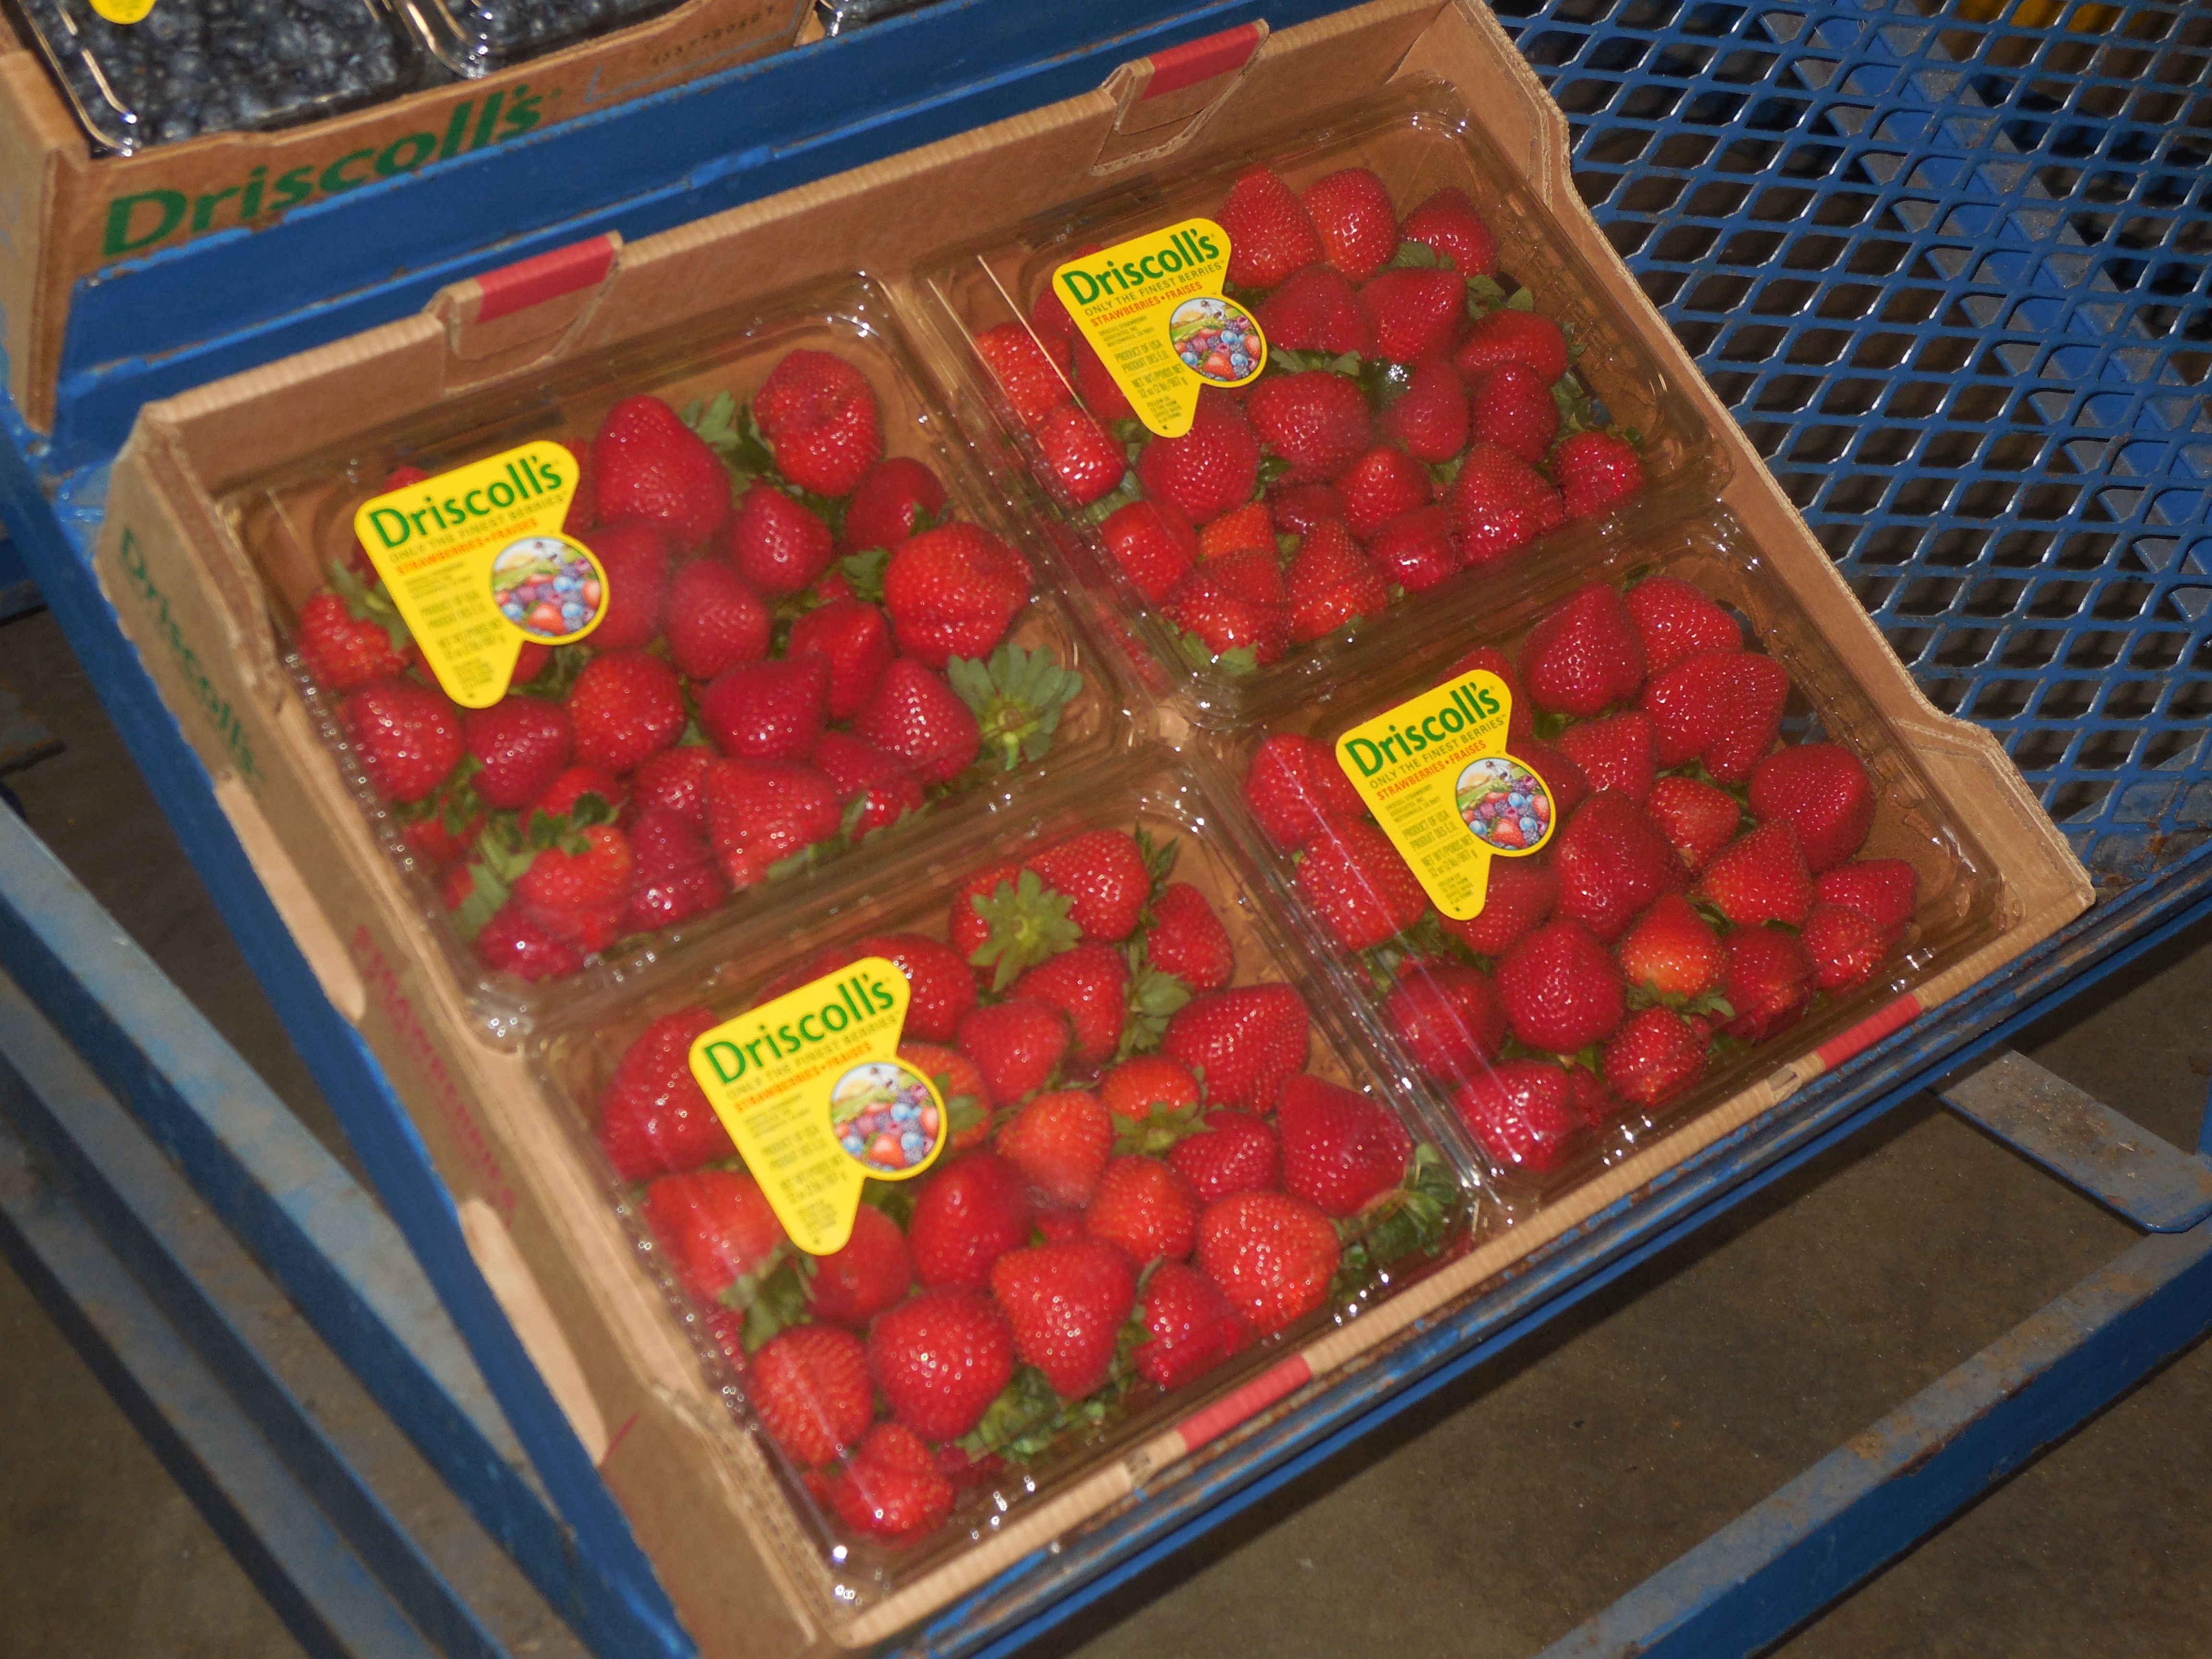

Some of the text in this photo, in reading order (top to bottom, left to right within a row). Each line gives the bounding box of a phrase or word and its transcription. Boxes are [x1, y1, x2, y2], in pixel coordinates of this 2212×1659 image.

[103, 84, 542, 256] Driscoll's
[1062, 228, 1219, 305] Driscoll's
[1085, 301, 1113, 316] ONLY
[1115, 292, 1135, 305] THE
[1139, 277, 1176, 297] FINEST
[369, 456, 562, 548] Driscoll's
[1345, 682, 1500, 777] Driscoll's
[1370, 771, 1397, 789] ONLY
[1399, 758, 1421, 774] THE
[1422, 739, 1459, 762] FINEST
[704, 974, 893, 1084] Driscoll's
